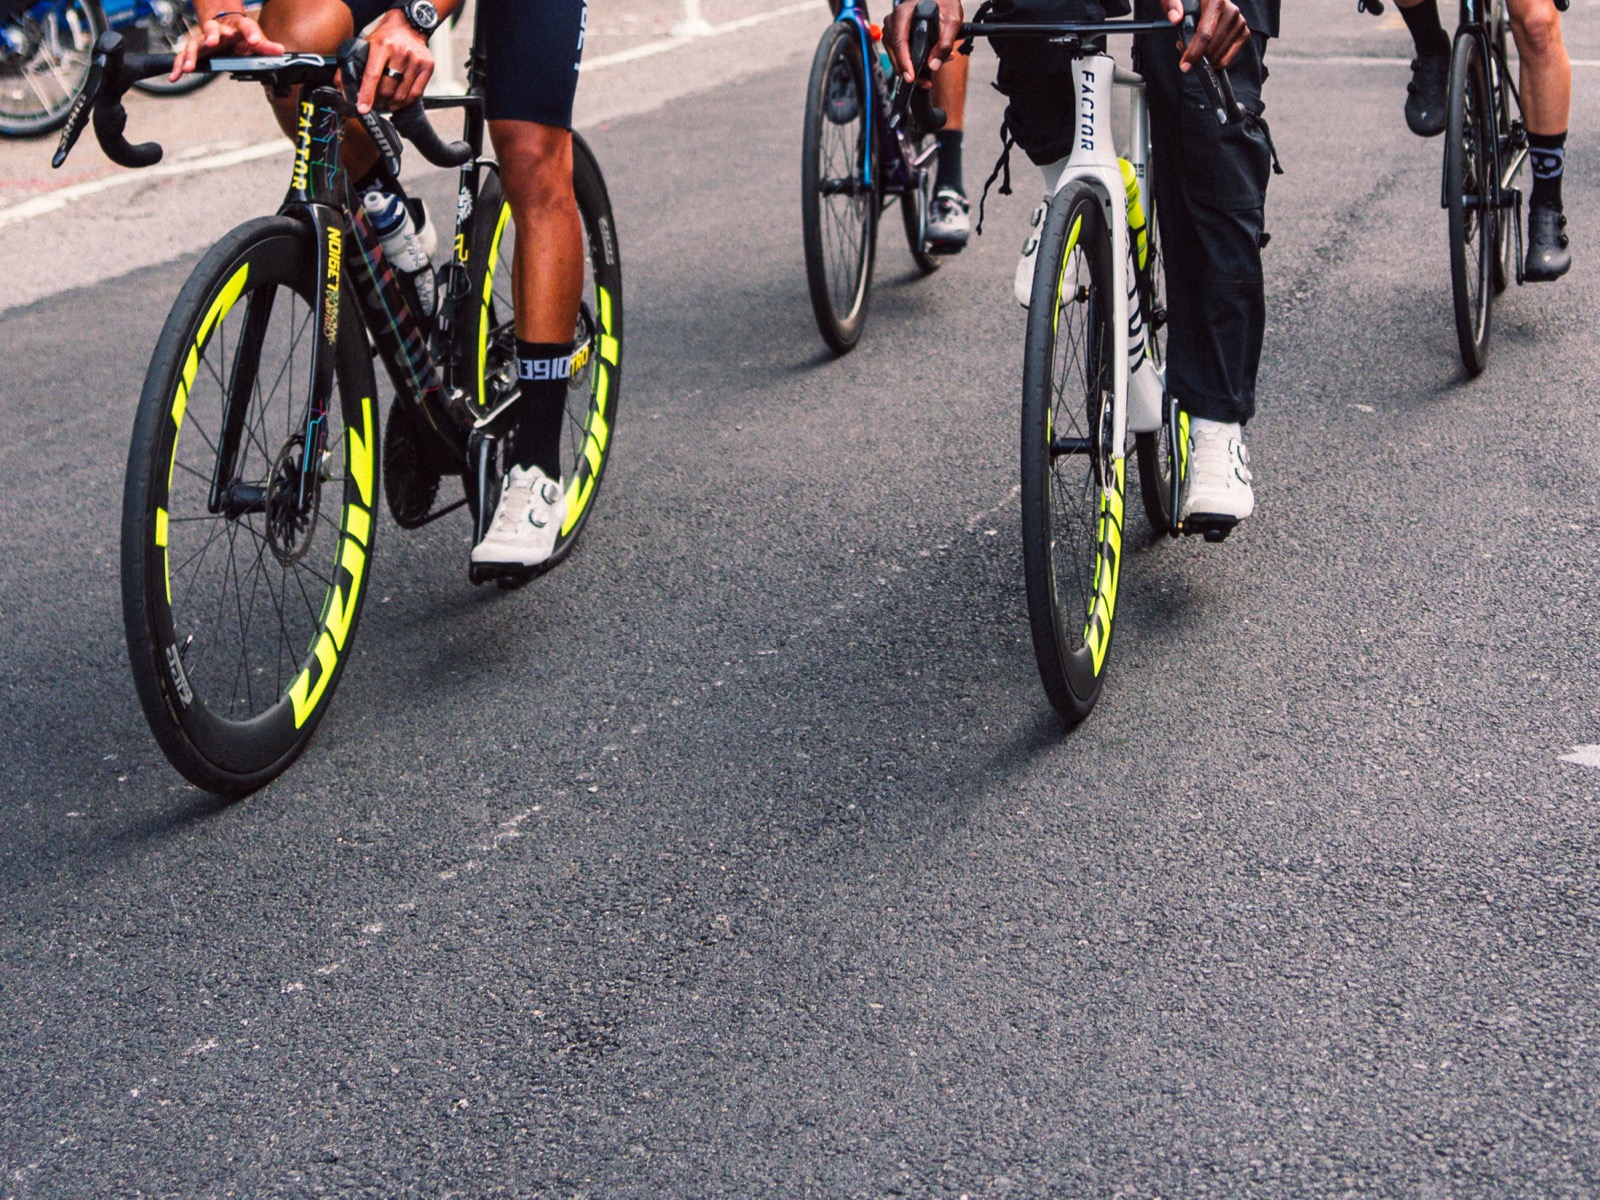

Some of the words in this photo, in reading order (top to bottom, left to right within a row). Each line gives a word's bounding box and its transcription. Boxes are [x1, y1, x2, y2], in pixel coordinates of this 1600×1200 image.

[291, 101, 315, 191] FACTOR
[362, 112, 395, 158] RAM
[1081, 69, 1095, 151] FACTOR
